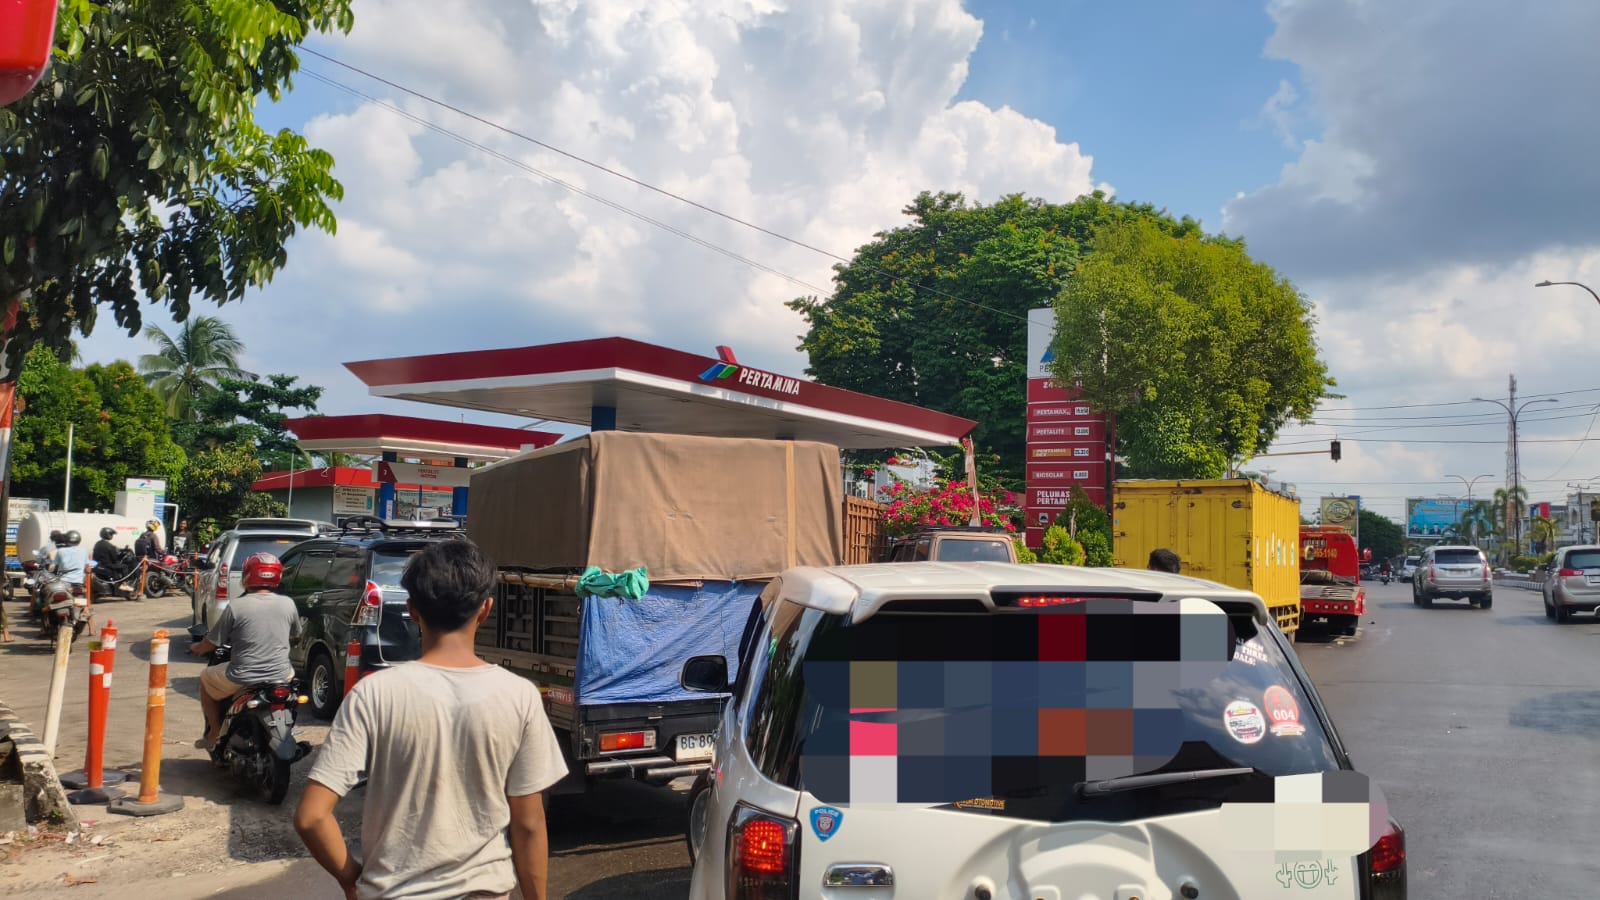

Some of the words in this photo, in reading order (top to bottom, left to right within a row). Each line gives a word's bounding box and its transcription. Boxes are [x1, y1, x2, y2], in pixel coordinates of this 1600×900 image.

[738, 367, 800, 395] PERTAMINA
[1234, 652, 1256, 666] DALS!
[1273, 709, 1296, 720] 004
[681, 735, 695, 750] BG
[699, 734, 714, 748] 89
[814, 808, 839, 818] POLICE
